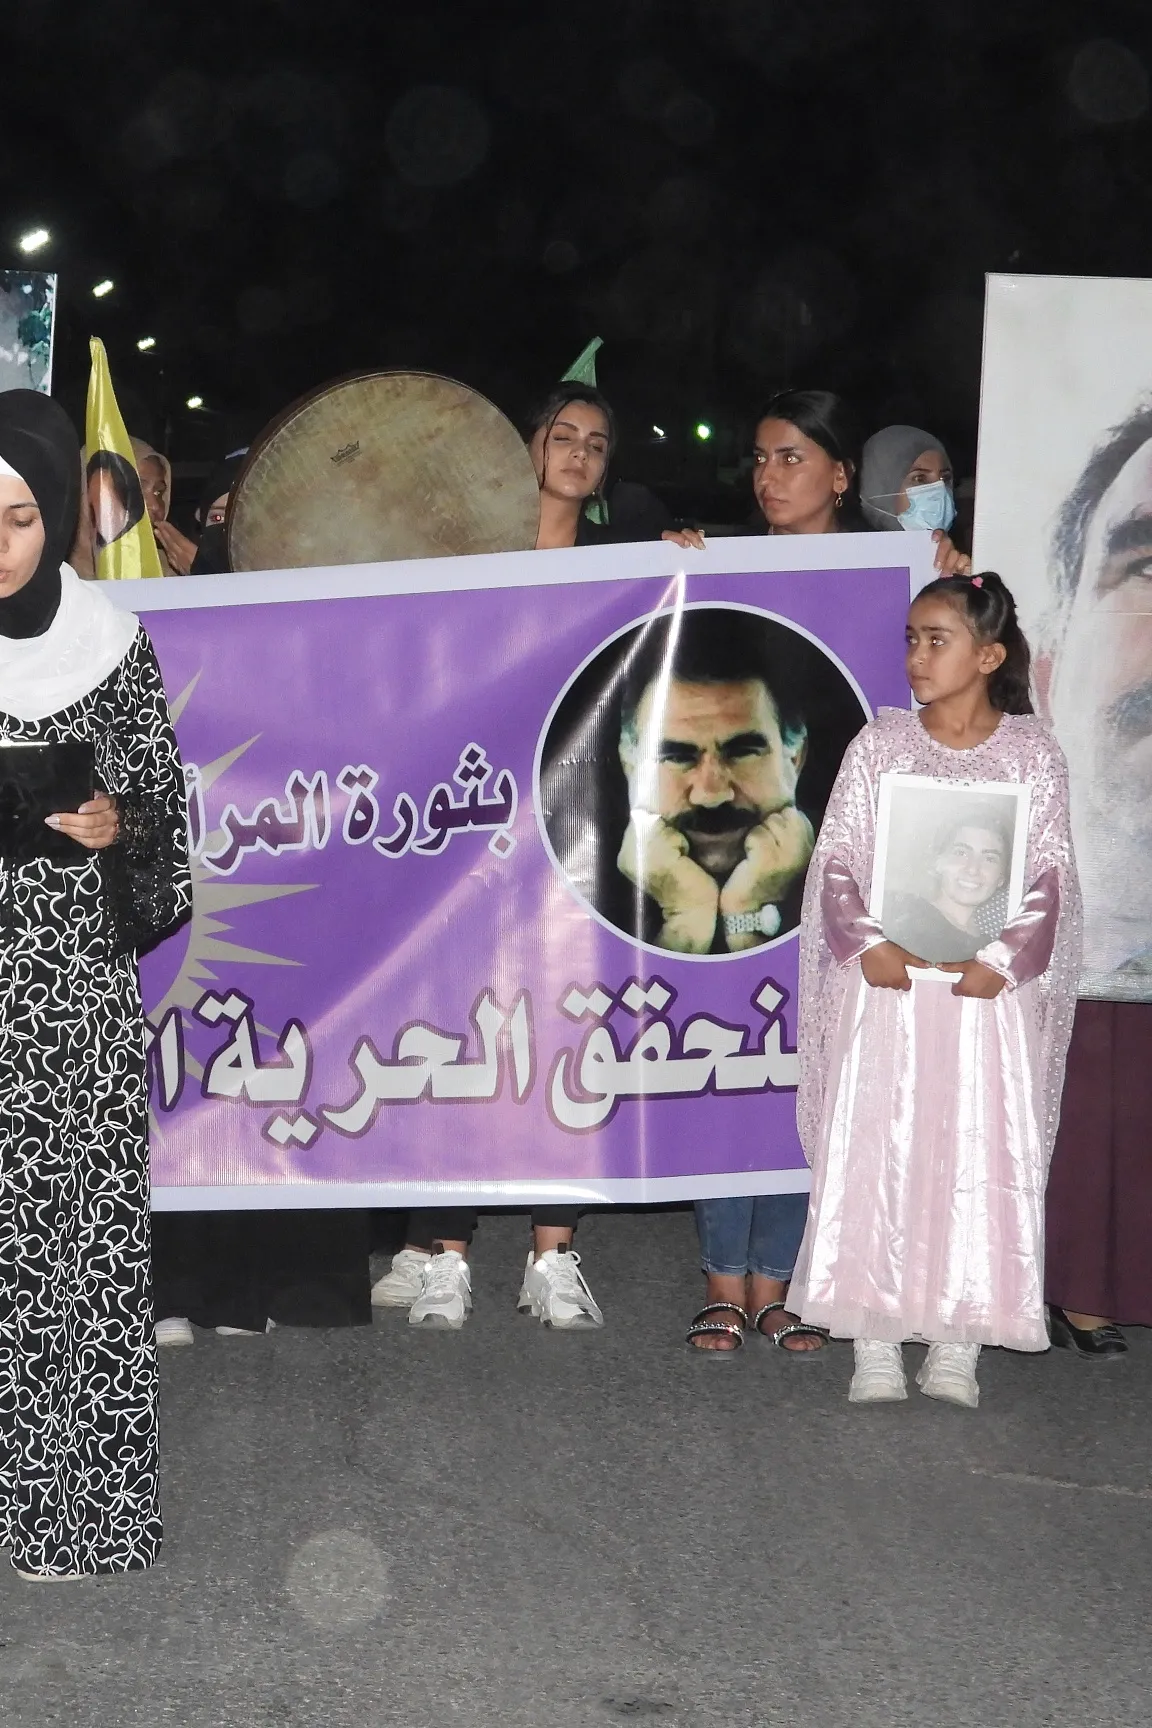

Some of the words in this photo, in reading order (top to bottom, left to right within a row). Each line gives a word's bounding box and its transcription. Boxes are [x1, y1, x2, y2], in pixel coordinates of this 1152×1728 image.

[185, 763, 331, 876] المرأ
[336, 742, 518, 859] بثورة
[193, 989, 536, 1150] الحرية
[550, 981, 800, 1134] نحقق
